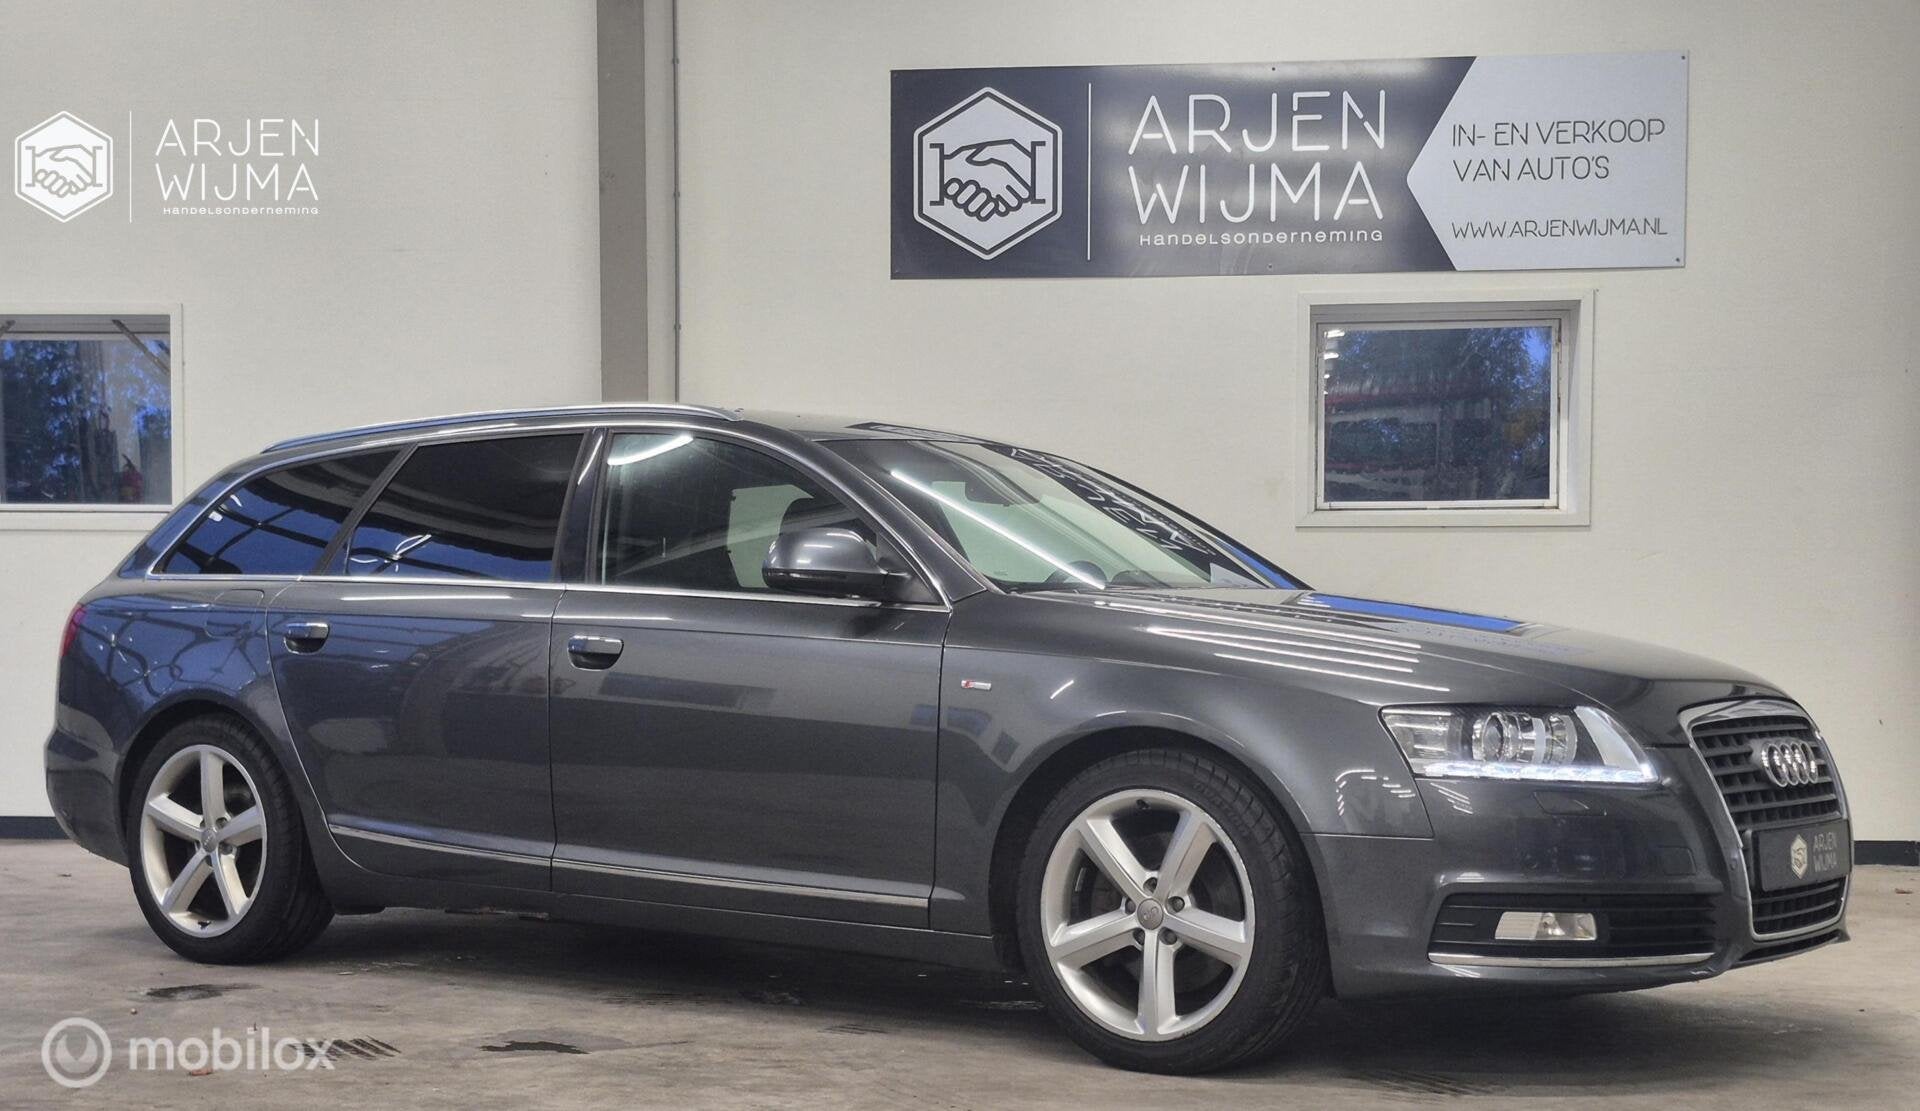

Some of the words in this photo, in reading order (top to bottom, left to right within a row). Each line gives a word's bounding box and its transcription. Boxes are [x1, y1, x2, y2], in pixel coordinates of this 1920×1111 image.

[1128, 89, 1386, 155] ARJEN
[1452, 123, 1486, 147] IN-
[1494, 122, 1529, 146] EN
[1536, 118, 1666, 145] VERKOOP
[1452, 158, 1510, 182] VAN
[1517, 155, 1610, 181] AUTO'S
[1128, 160, 1384, 224] WIJMA
[1451, 217, 1668, 239] WWW.ARJENWIJMA.NL
